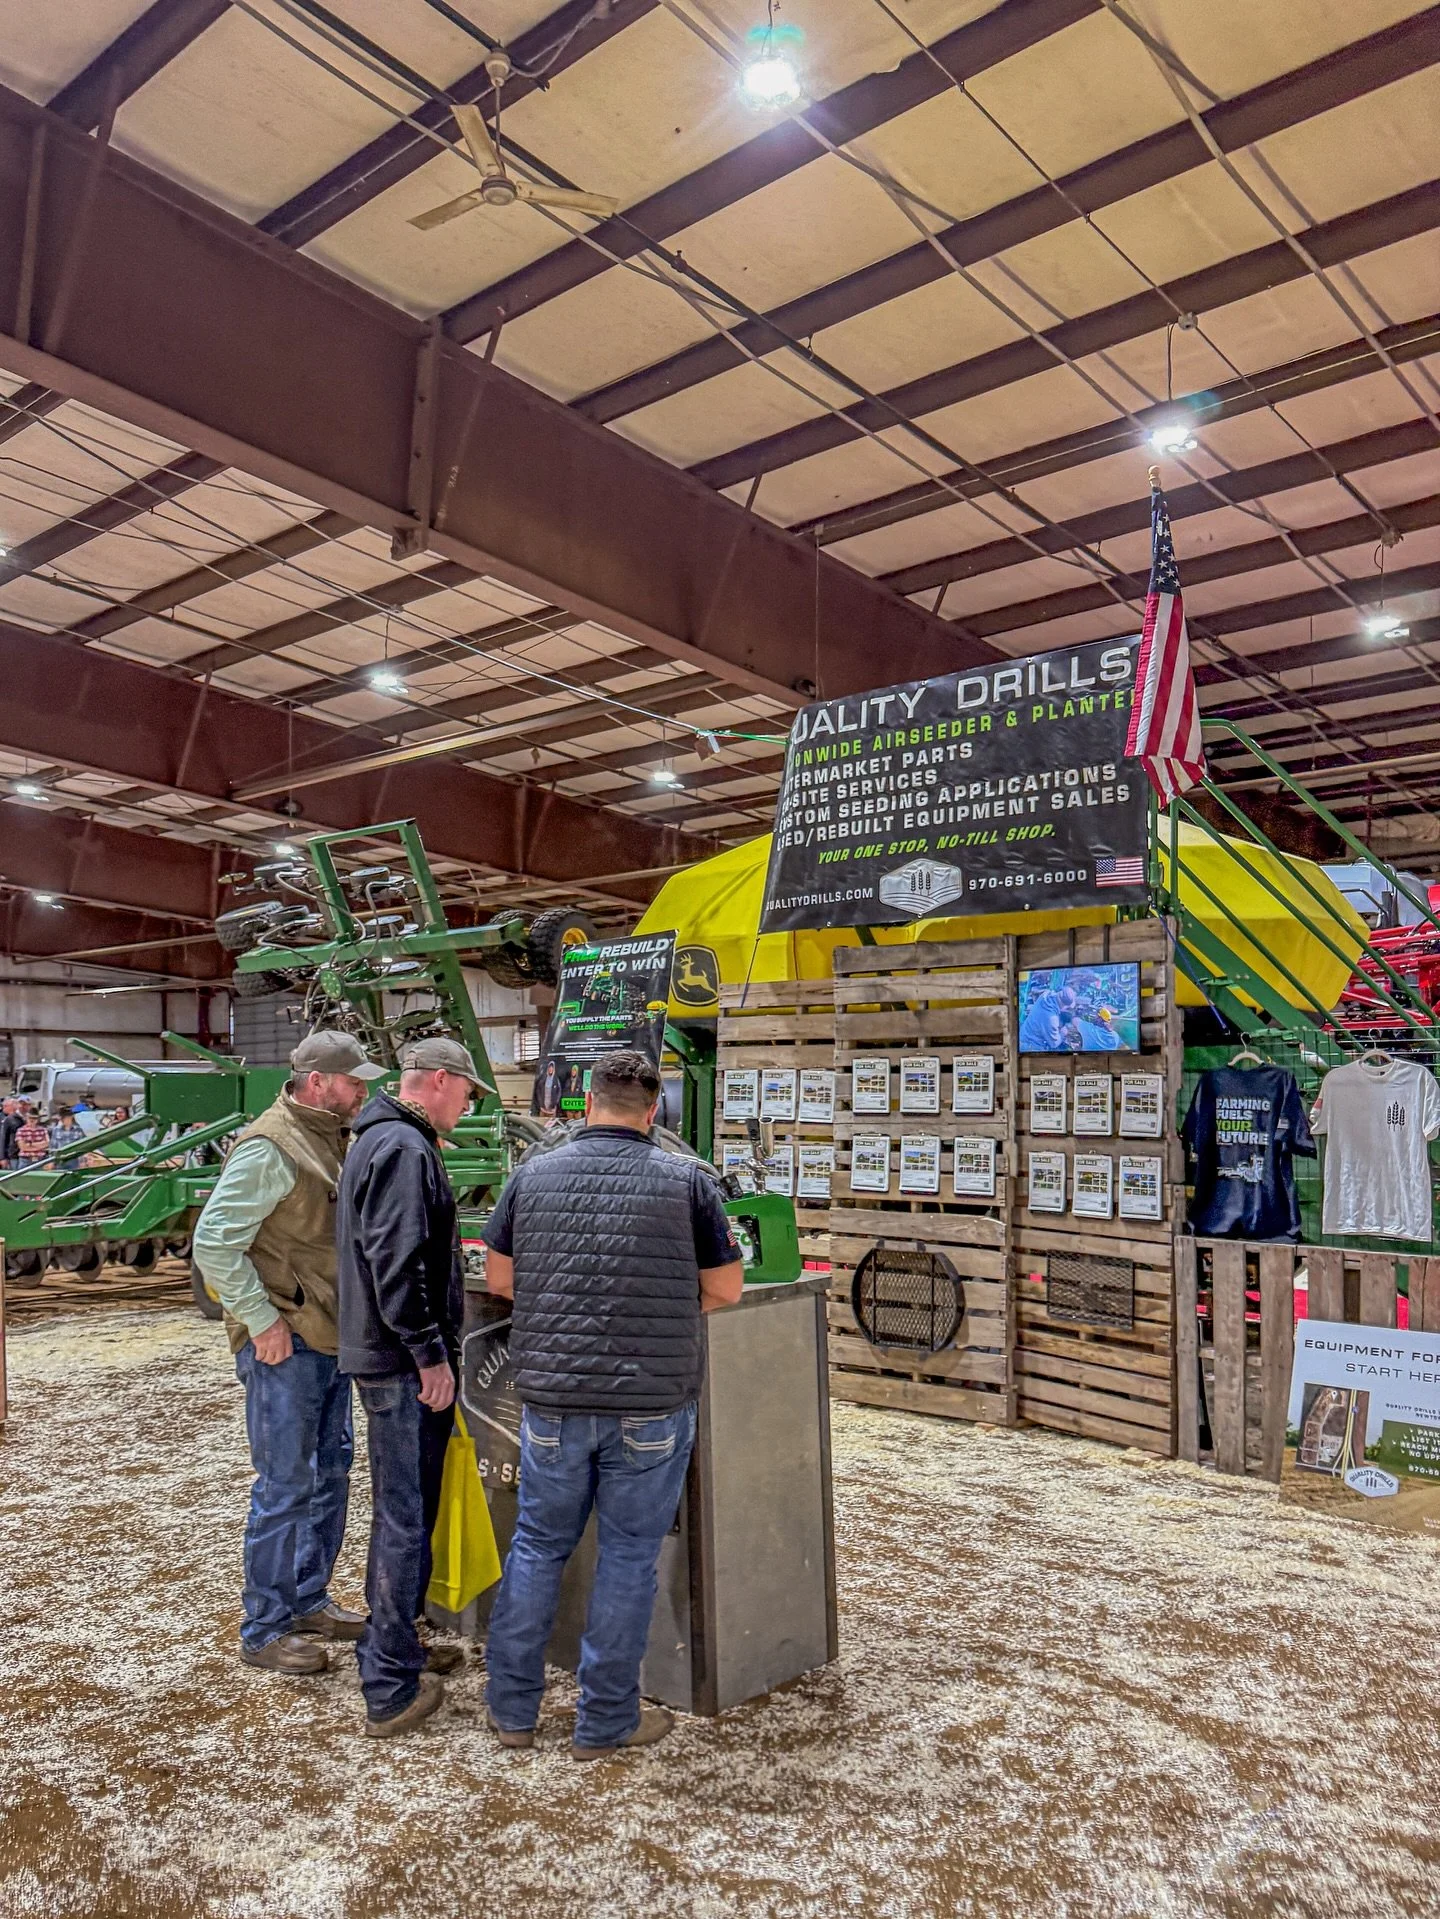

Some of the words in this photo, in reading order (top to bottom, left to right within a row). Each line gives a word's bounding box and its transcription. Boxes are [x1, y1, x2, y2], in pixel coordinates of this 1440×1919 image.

[791, 687, 926, 745] UALITY
[957, 646, 1132, 710] DRILLS
[795, 739, 863, 768] ONWIDE
[873, 714, 992, 752] AIRSEEDER
[1006, 711, 1018, 728] &
[784, 756, 892, 797] TERMARKET
[902, 742, 973, 769] PARTS
[836, 768, 938, 800] SERVICES
[838, 790, 929, 819] SEEDING
[938, 763, 1117, 804] APPLICATIONS
[903, 795, 1040, 830] EQUIPMENT
[1051, 784, 1130, 811] SALES
[818, 848, 848, 864] YOUR
[854, 843, 884, 859] ONE
[888, 838, 929, 855] STOP,
[936, 829, 999, 850] NO-TILL
[1005, 823, 1056, 842] SHOP.
[968, 869, 1088, 891] 970-691-6000
[561, 963, 604, 980] ENTER
[608, 960, 628, 973] TO
[632, 957, 667, 972] WIN
[1216, 1097, 1271, 1111] FARMING
[1216, 1109, 1253, 1120] FUELS
[1216, 1120, 1252, 1131] YOUR
[1216, 1130, 1269, 1145] FUTURE
[1304, 1339, 1405, 1360] EQUIPMENT
[1345, 1363, 1403, 1378] START
